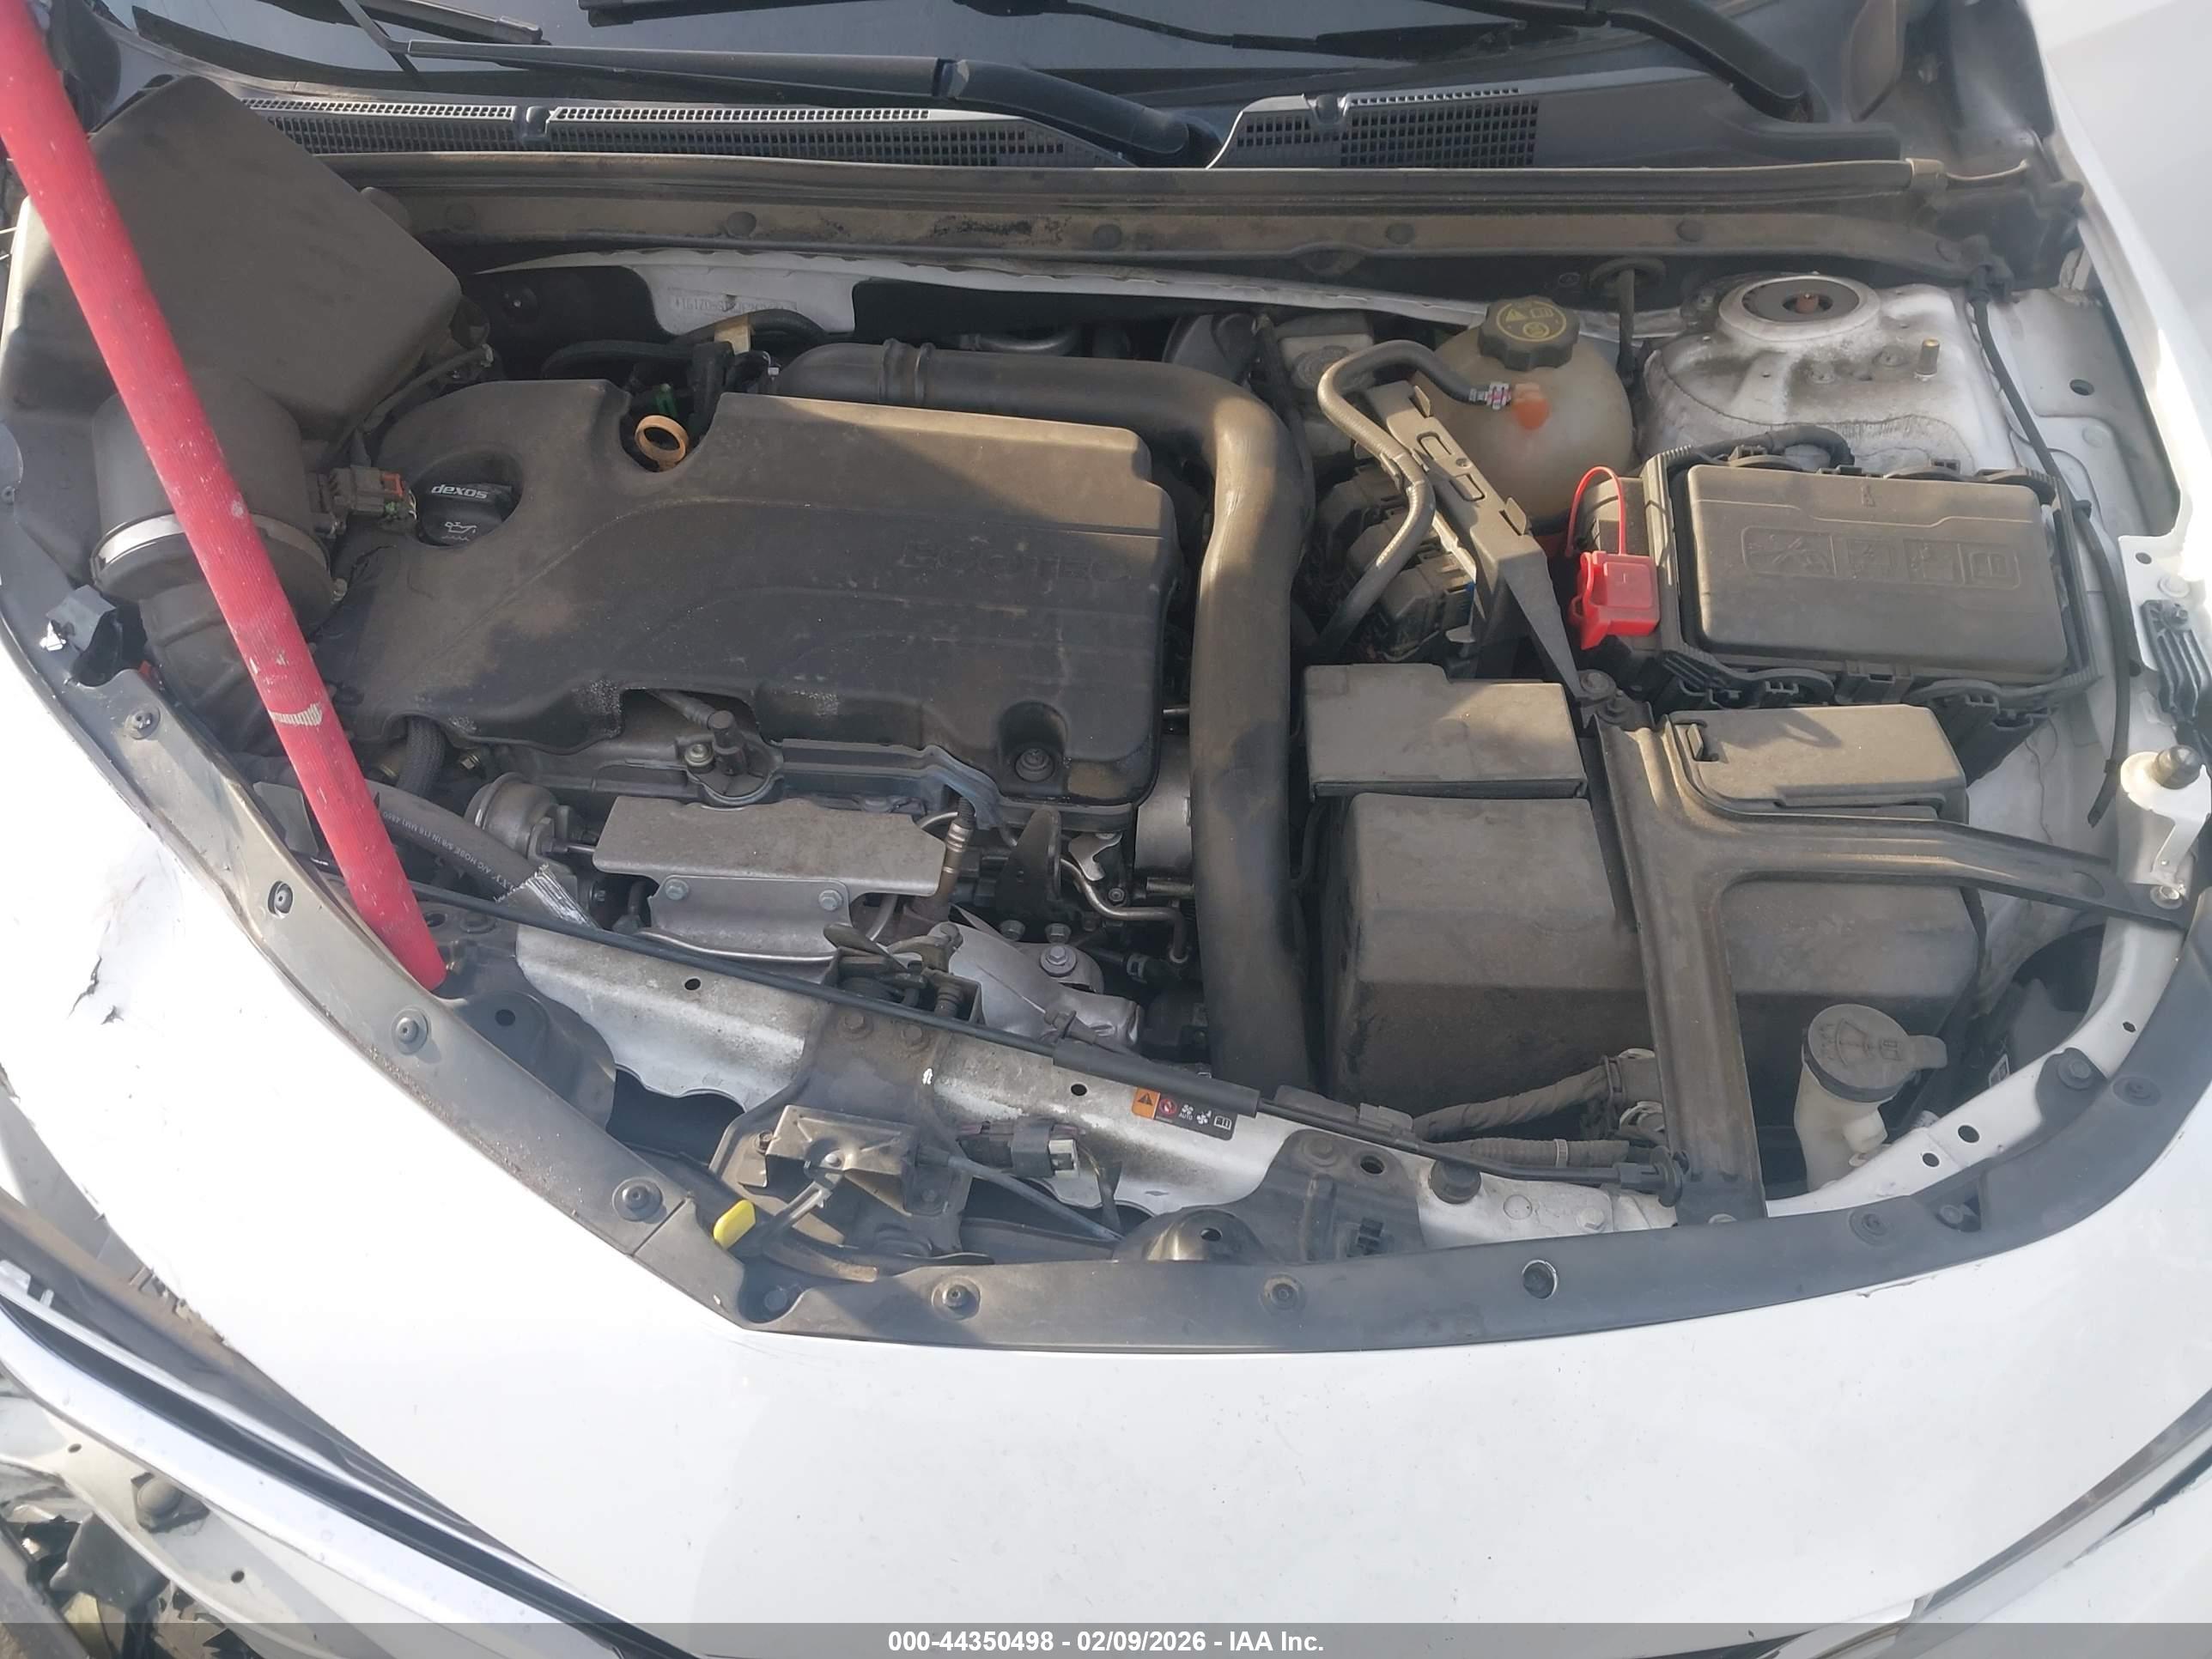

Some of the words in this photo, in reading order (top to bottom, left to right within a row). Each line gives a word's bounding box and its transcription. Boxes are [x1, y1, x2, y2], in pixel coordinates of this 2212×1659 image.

[431, 483, 489, 499] dexos
[896, 539, 1132, 584] ECOTEC
[1179, 1112, 1193, 1121] AUTO
